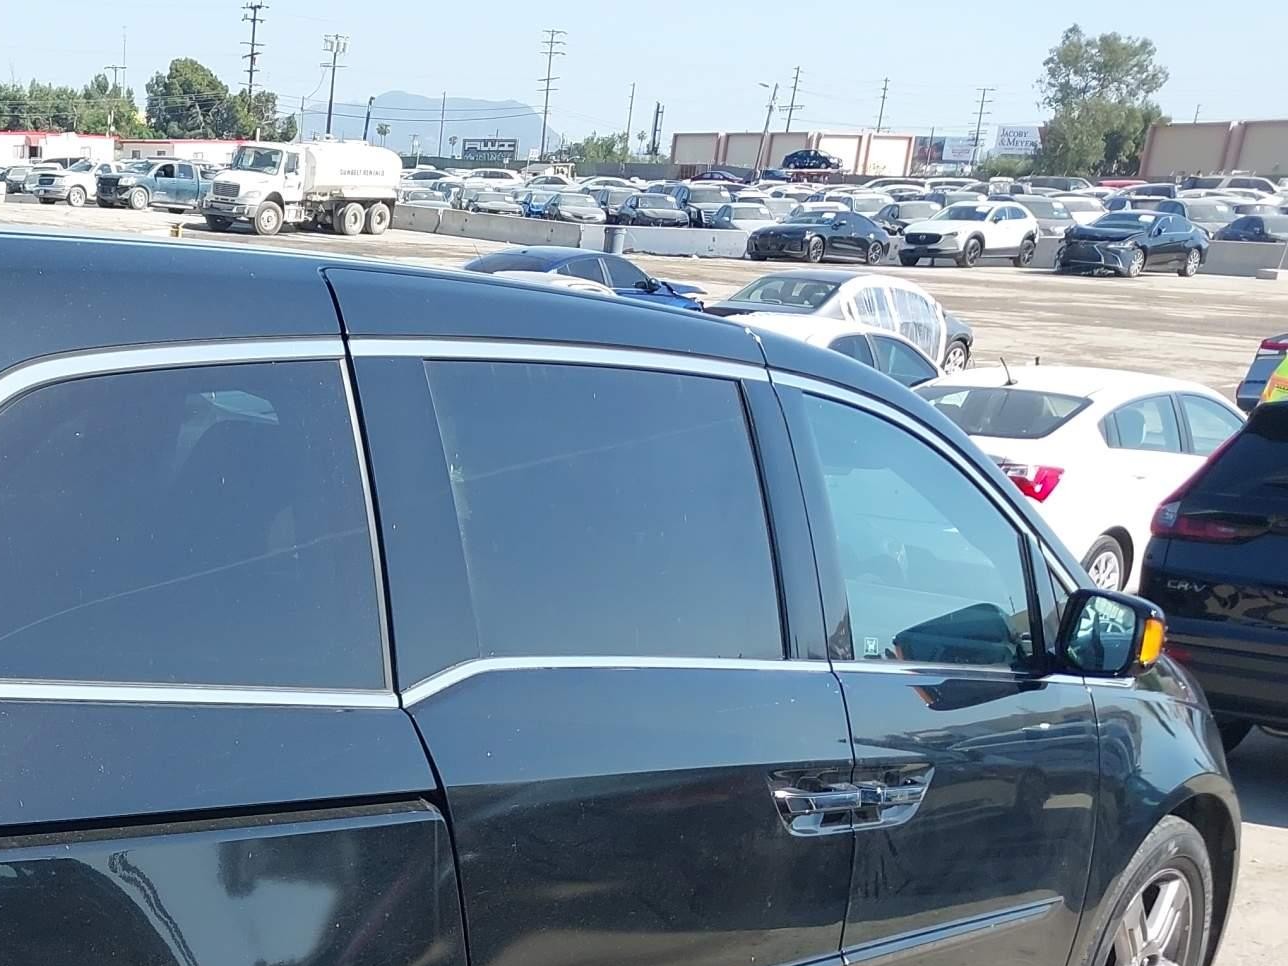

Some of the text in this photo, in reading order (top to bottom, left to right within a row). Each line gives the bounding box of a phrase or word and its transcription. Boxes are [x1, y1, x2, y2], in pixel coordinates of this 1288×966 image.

[1000, 127, 1029, 138] JACOBY
[999, 138, 1006, 146] &
[1167, 578, 1206, 593] CR-V
